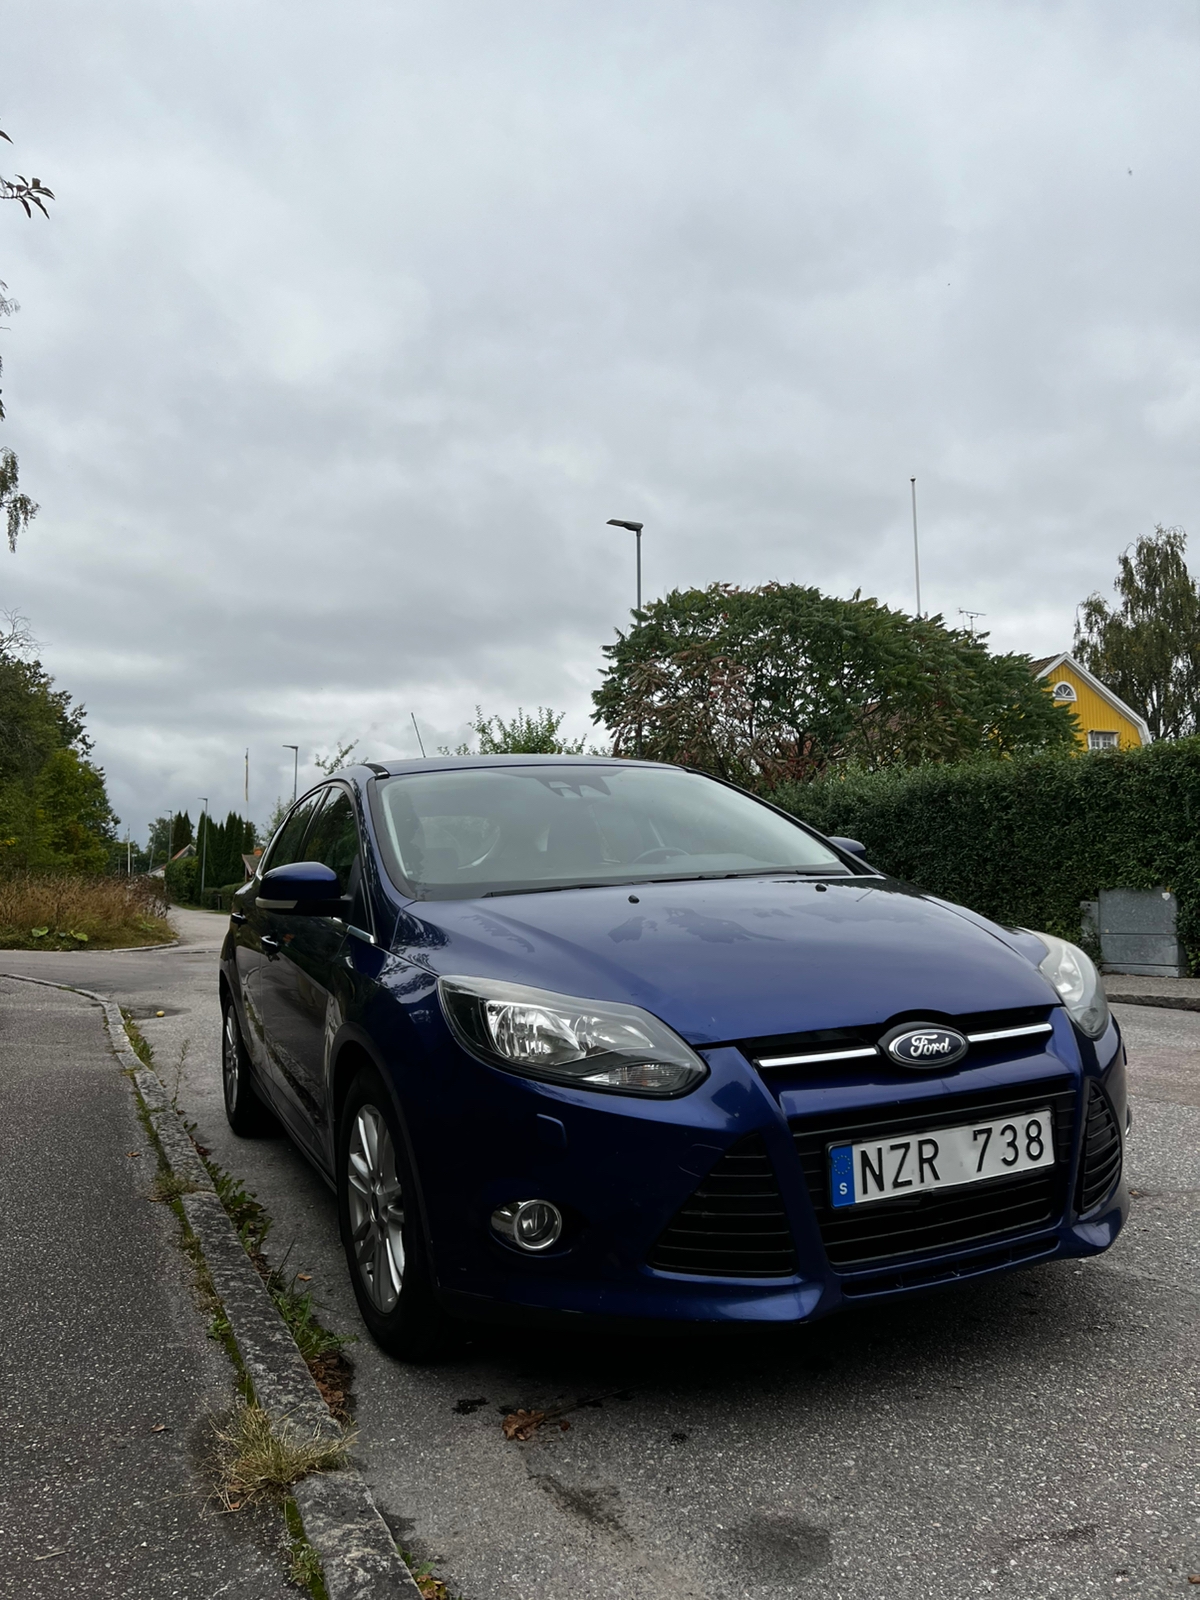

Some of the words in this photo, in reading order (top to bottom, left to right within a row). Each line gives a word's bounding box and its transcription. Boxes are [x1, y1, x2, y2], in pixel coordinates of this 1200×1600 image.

[910, 1034, 951, 1057] Ford
[860, 1138, 940, 1195] NZR
[972, 1119, 1044, 1173] 738
[839, 1183, 848, 1195] S
